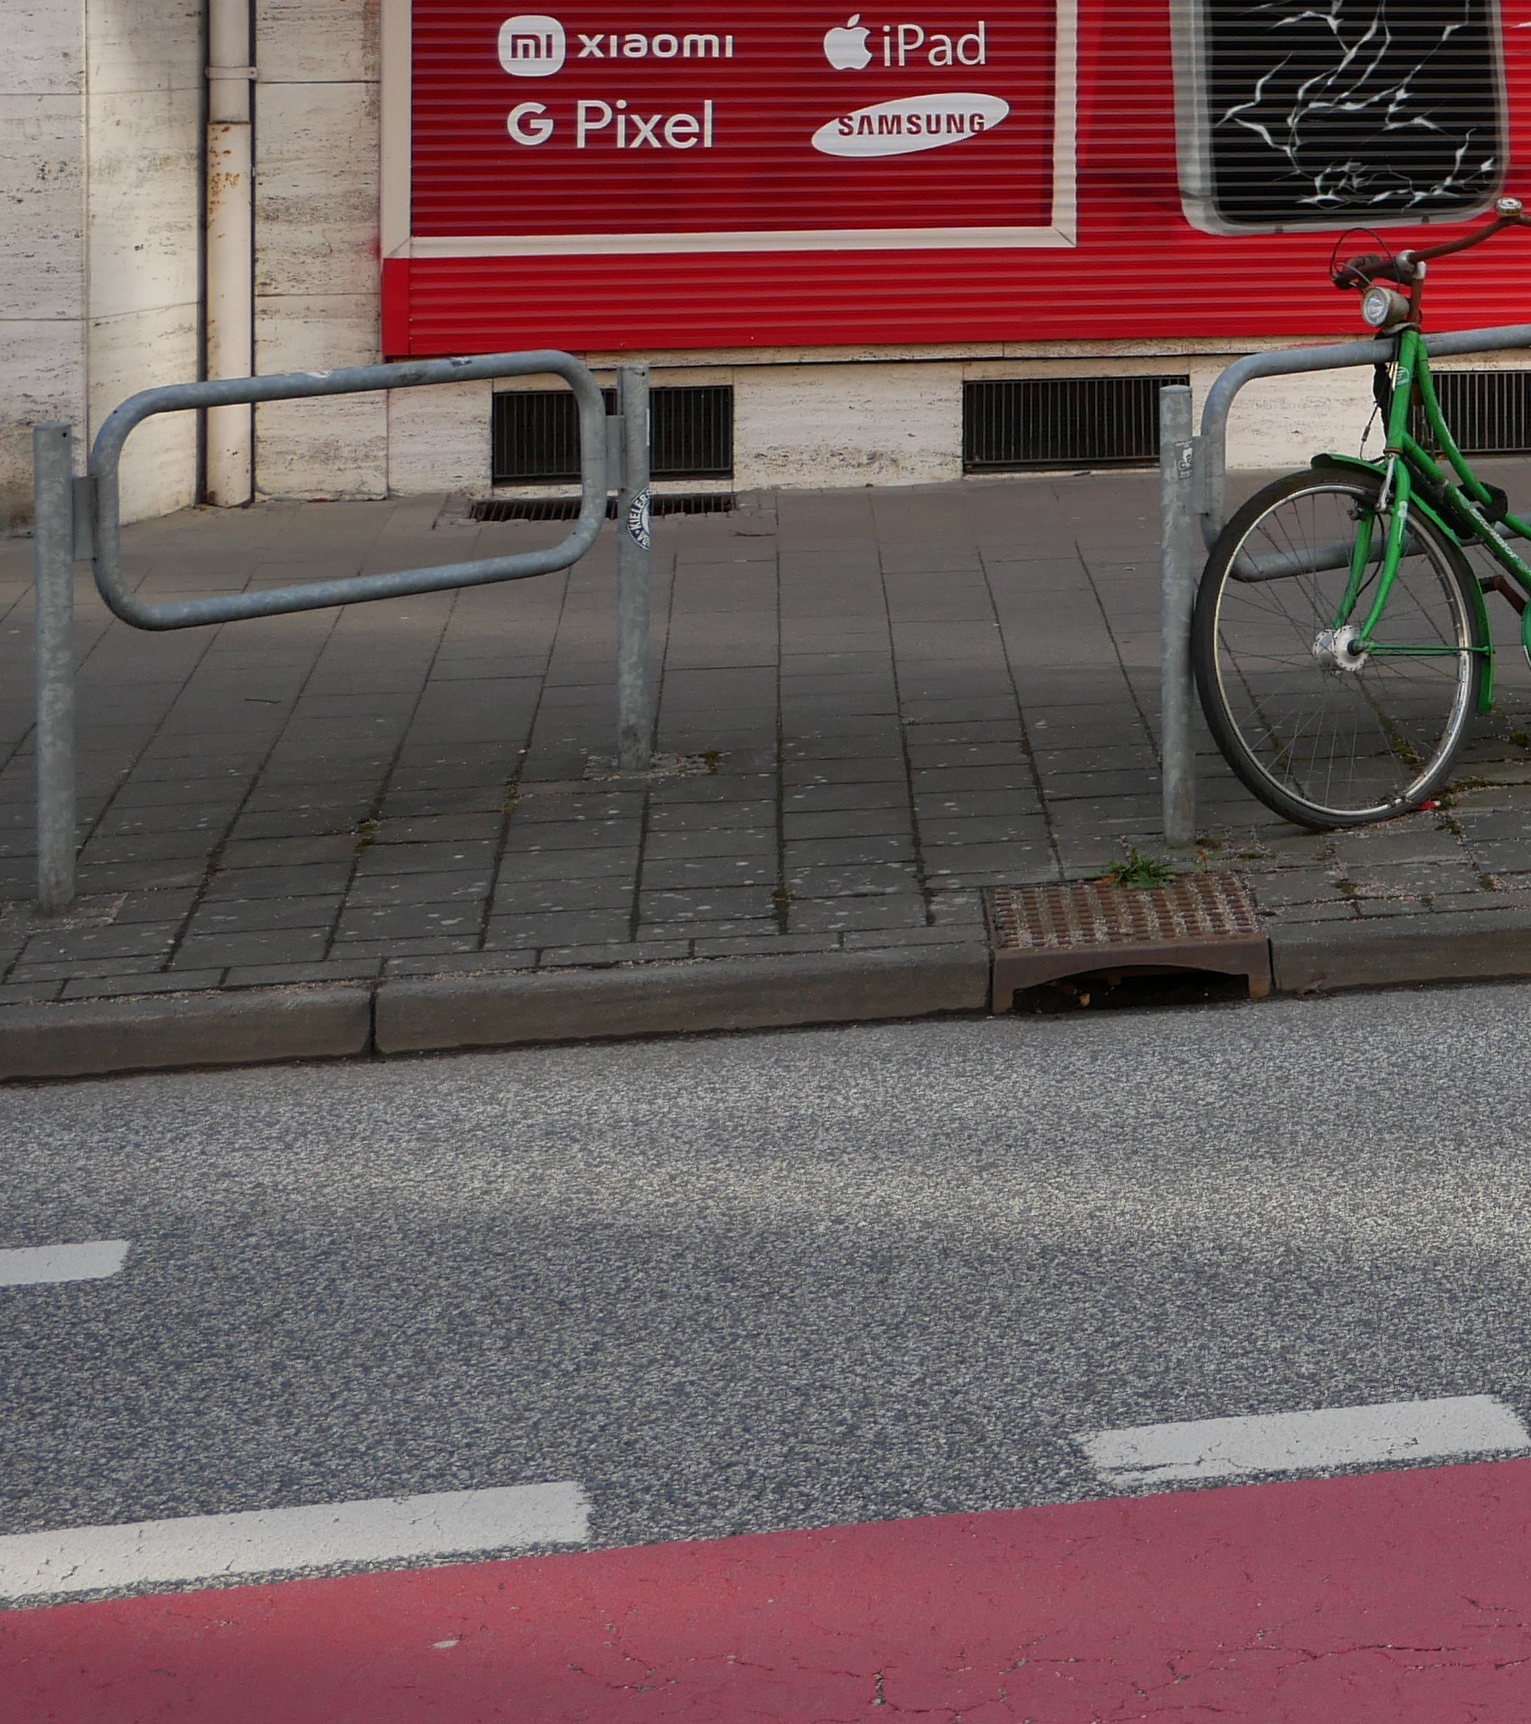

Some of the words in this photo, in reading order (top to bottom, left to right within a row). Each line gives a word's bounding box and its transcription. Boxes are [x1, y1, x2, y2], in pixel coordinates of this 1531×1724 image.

[881, 20, 987, 67] iPad
[575, 99, 714, 149] Pixel
[837, 113, 986, 137] SAMSUNG
